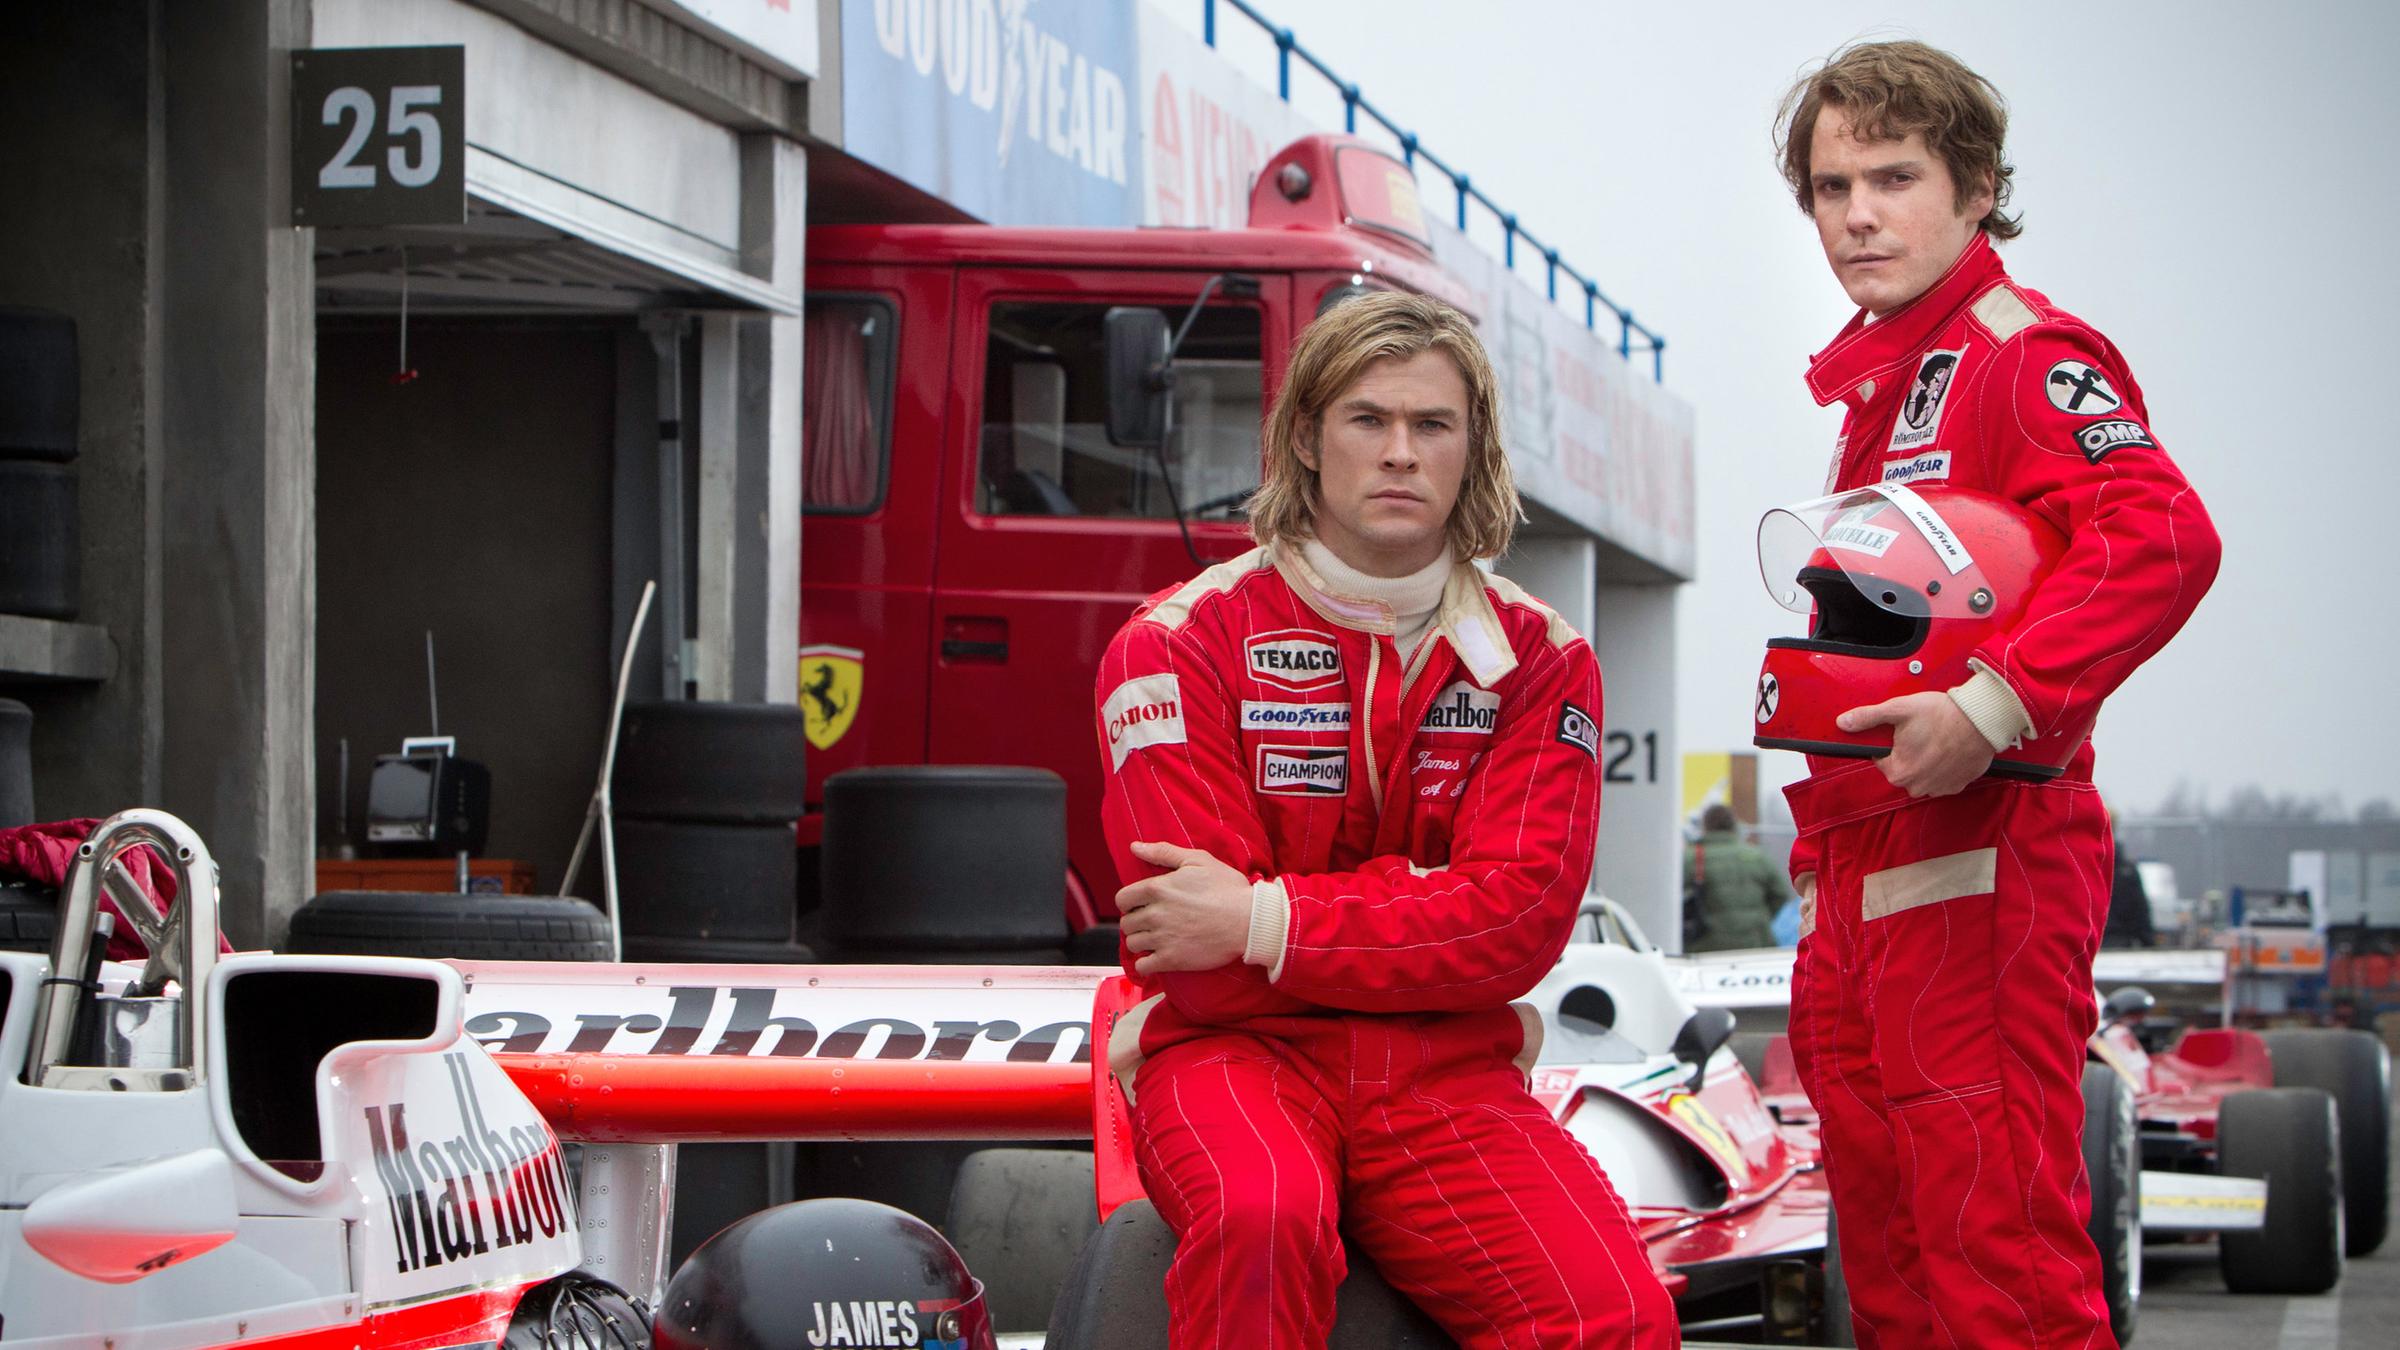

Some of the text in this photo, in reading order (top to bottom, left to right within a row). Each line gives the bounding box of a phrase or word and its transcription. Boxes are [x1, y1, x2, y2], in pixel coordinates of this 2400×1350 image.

[318, 85, 442, 188] 25
[2084, 424, 2145, 450] OMP
[1885, 459, 1943, 480] GOODYEAR
[1916, 511, 1957, 555] GOODYEAR
[1253, 649, 1338, 670] TEXACO
[1110, 701, 1177, 744] Canon
[1248, 708, 1351, 727] GOODYEAR
[1411, 751, 1460, 775] James
[1603, 730, 1657, 783] 21
[1267, 762, 1343, 780] CHAMPION
[1719, 976, 1791, 987] GOO
[464, 984, 1091, 1064] arlboro
[807, 1301, 919, 1347] JAMES
